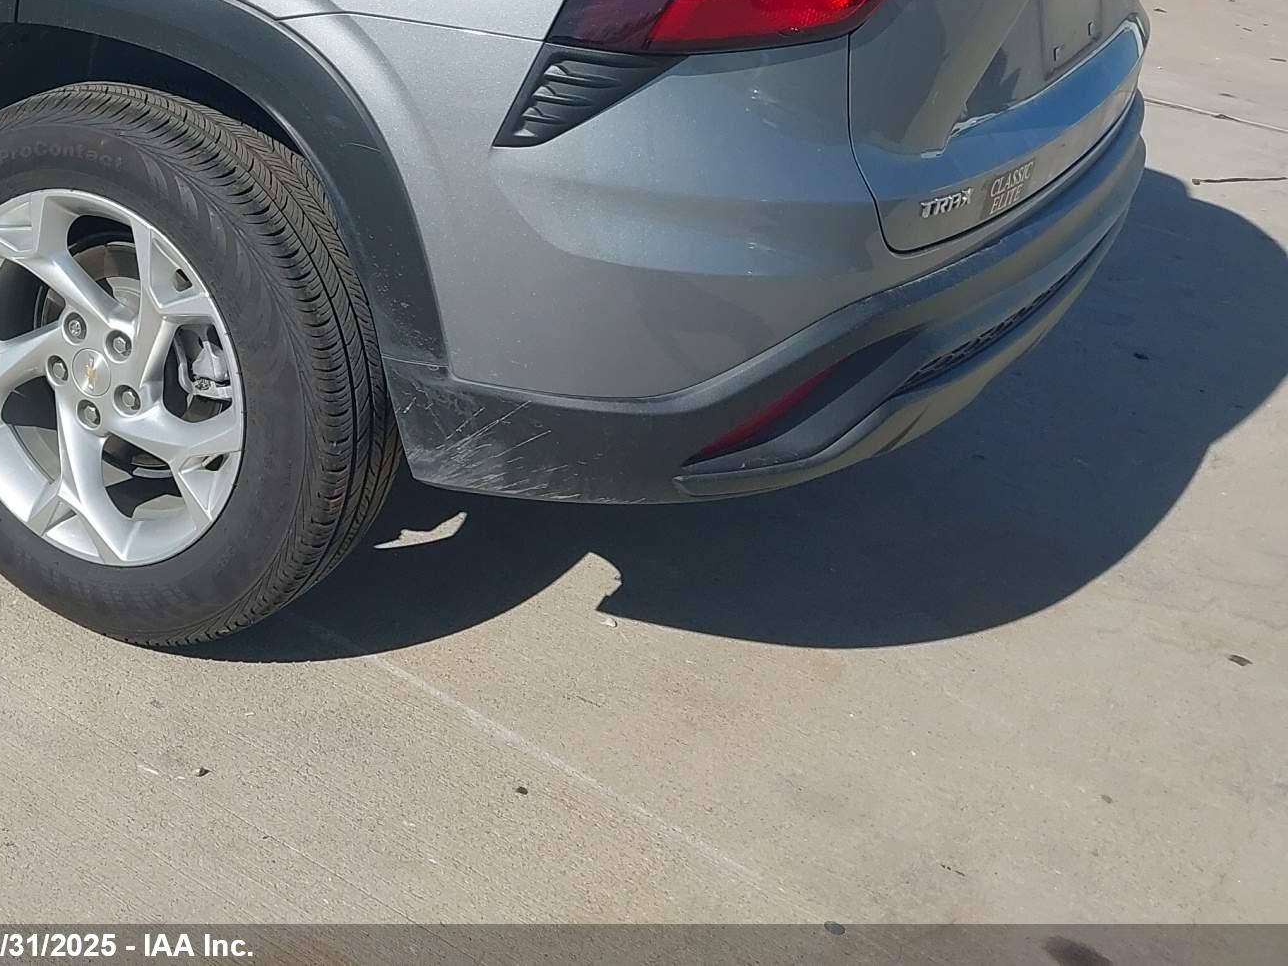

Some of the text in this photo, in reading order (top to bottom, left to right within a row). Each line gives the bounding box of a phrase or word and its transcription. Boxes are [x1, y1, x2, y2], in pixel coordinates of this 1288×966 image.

[991, 161, 1034, 197] CLASSIC
[920, 187, 972, 218] TRAX
[990, 184, 1024, 215] ELITE
